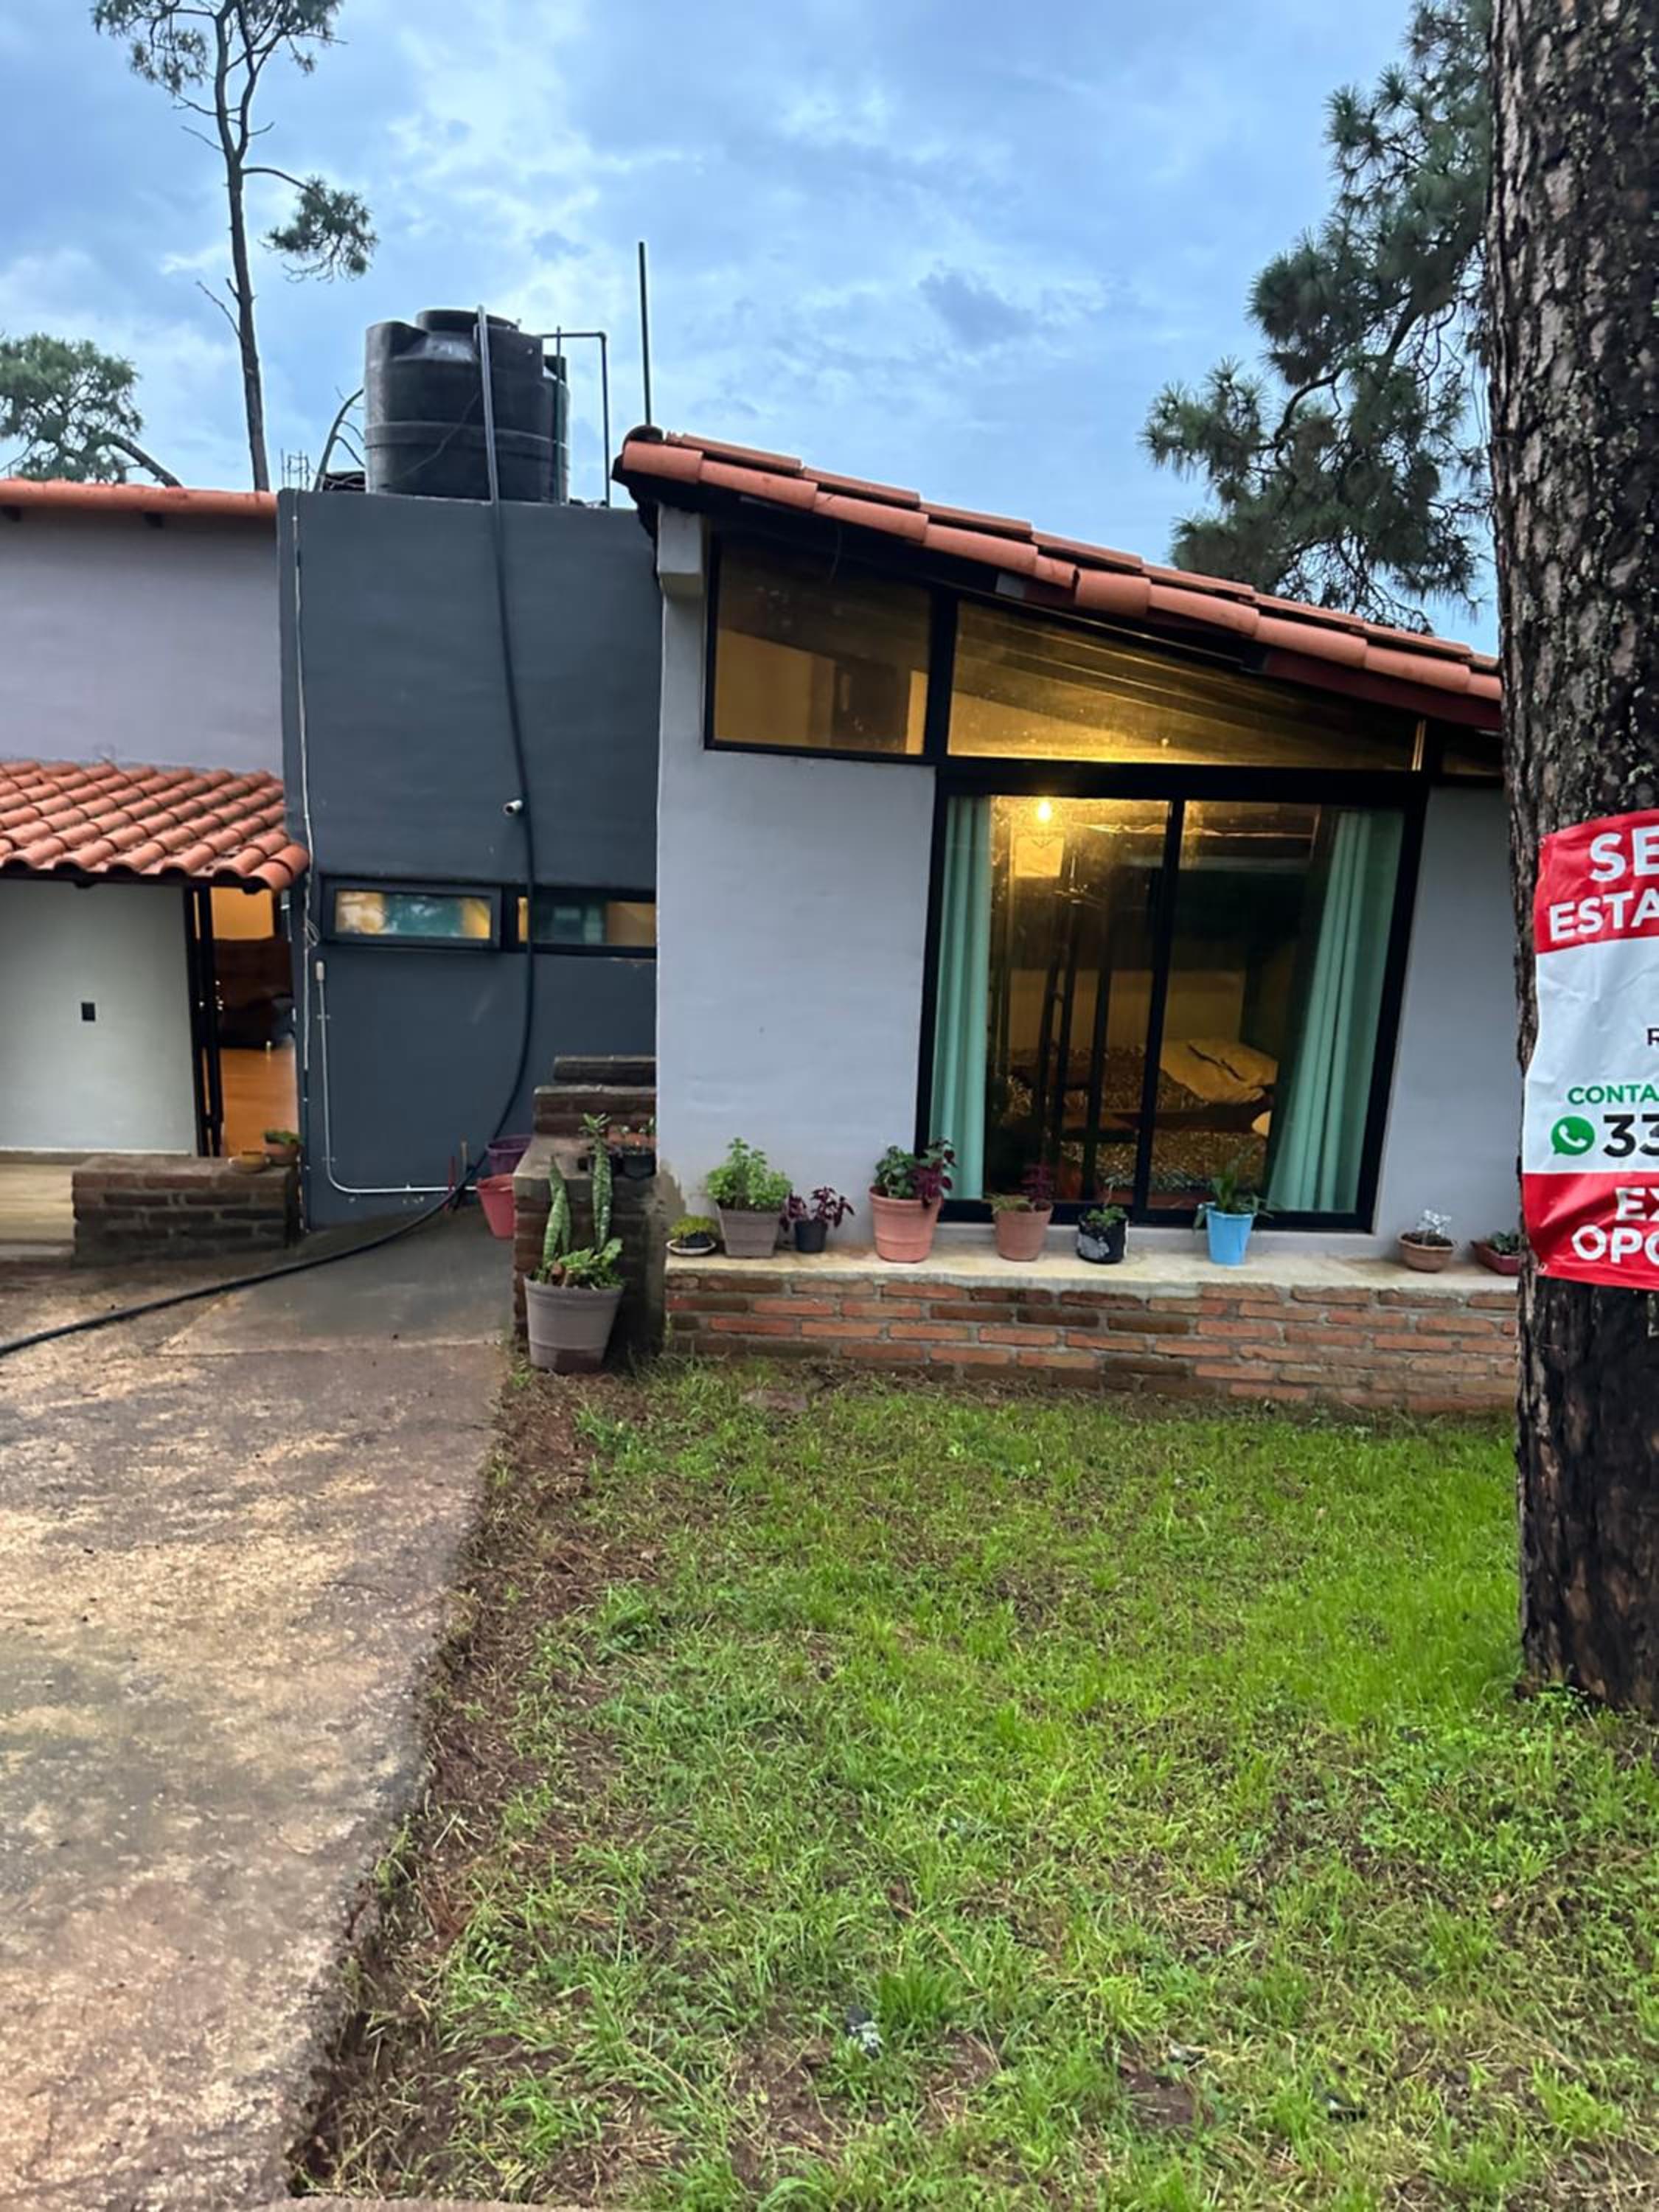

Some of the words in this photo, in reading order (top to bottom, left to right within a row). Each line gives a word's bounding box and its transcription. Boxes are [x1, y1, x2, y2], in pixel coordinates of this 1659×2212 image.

[1589, 825, 1659, 882] SE
[1548, 887, 1659, 942] ESTA
[1568, 1084, 1659, 1105] CONTA
[1603, 1113, 1659, 1158] 33
